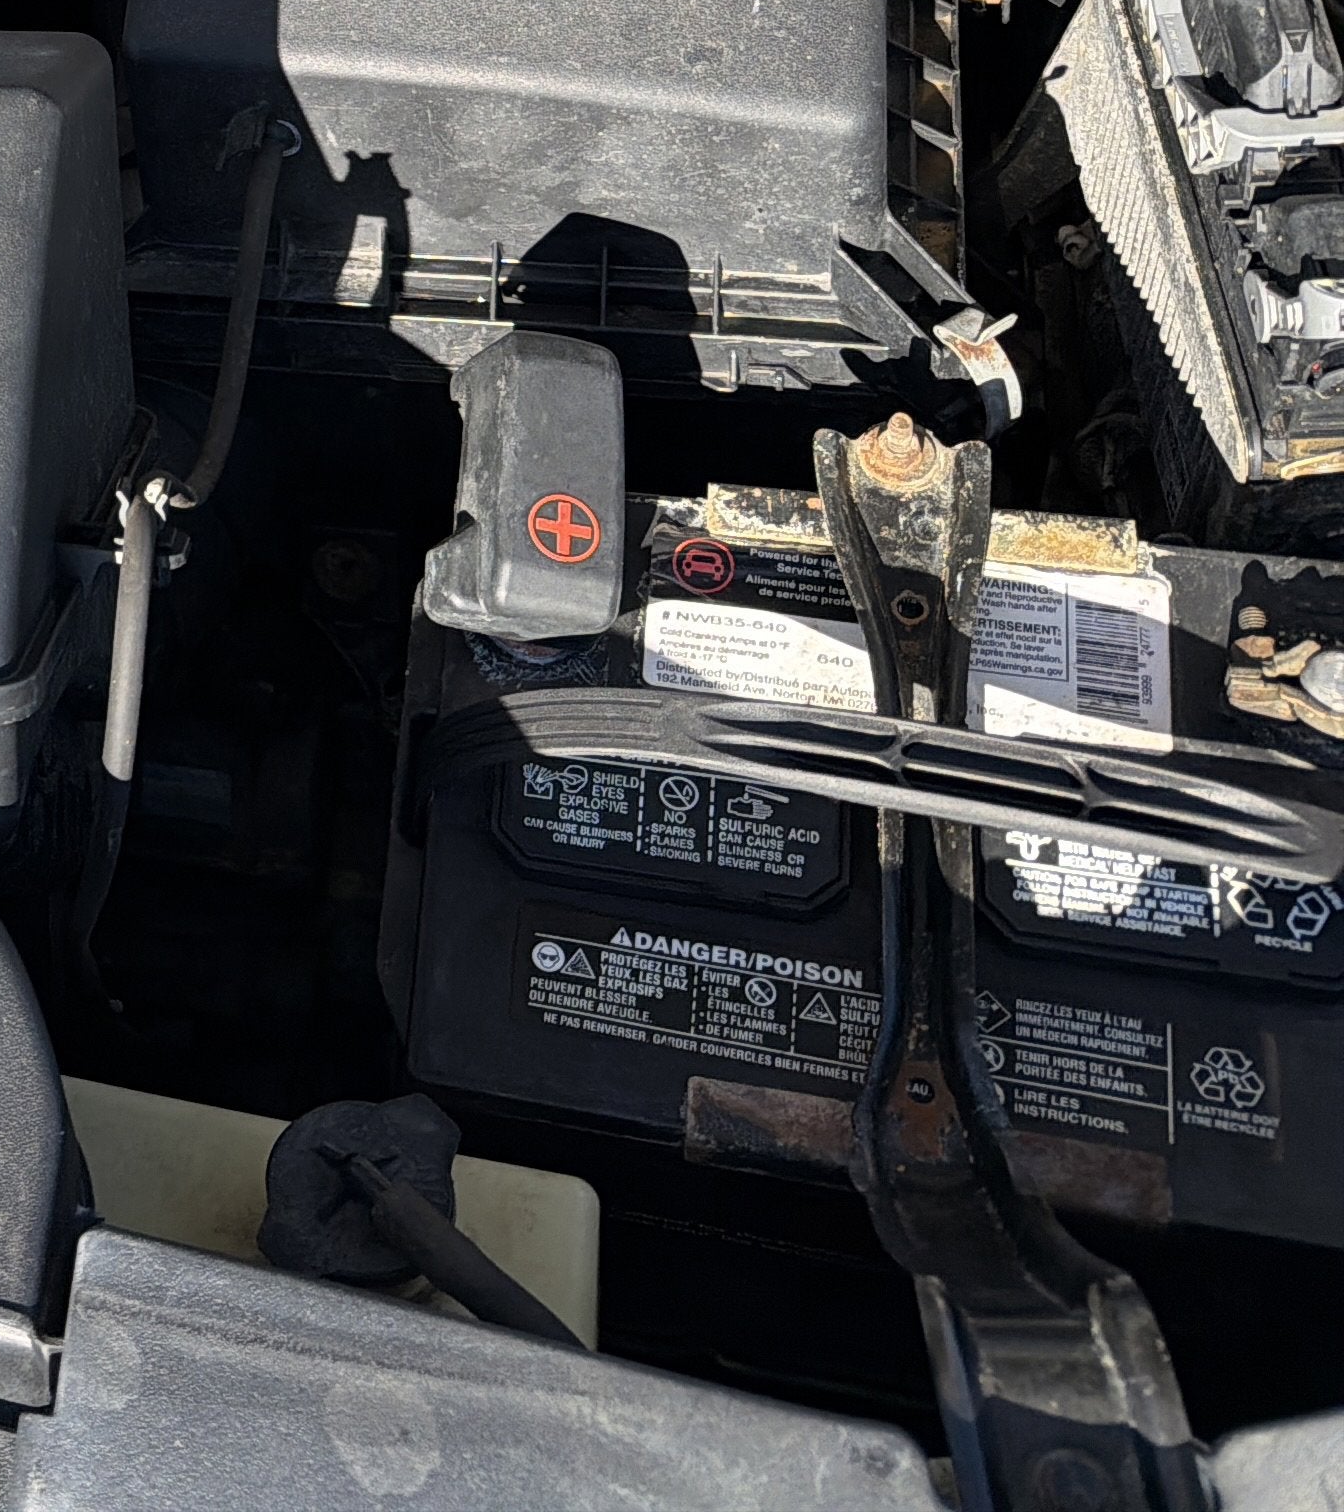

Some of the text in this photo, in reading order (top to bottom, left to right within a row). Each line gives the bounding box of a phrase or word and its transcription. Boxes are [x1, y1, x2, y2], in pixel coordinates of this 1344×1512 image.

[750, 548, 818, 567] Powered for
[776, 563, 820, 579] Service
[745, 574, 846, 596] Alimenté pour les
[758, 586, 819, 603] de service
[981, 598, 1058, 614] Wash hands after
[990, 591, 1003, 600] and
[1004, 592, 1063, 606] Reproductive
[661, 610, 788, 634] # NWB35-640
[976, 618, 1062, 637] RTISSEMENT:
[659, 626, 682, 637] Cold
[729, 635, 757, 649] Amps
[985, 630, 994, 638] et
[1015, 633, 1037, 642] nocif
[1039, 636, 1052, 644] sur
[1053, 636, 1062, 645] la
[1010, 641, 1045, 653] Se laver
[703, 645, 716, 653] au
[979, 647, 1004, 658] après
[1006, 650, 1063, 664] manipulation.
[817, 653, 854, 668] 640
[656, 660, 722, 678] Distributed
[725, 668, 800, 689] by/Distribué
[681, 676, 740, 692] Mansfield
[592, 771, 640, 789] SHIELD
[592, 785, 625, 800] EYES
[559, 793, 629, 815] EXPLOSIVE
[558, 808, 600, 824] GASES
[664, 811, 687, 825] NO
[523, 816, 634, 843] CAN CAUSE BLINDNESS
[651, 822, 696, 839] SPARKS
[718, 817, 820, 844] SULFURIC ACID
[552, 833, 606, 849] OR INJURY
[650, 835, 695, 850] FLAMES
[718, 832, 785, 851] CAN CAUSE
[649, 846, 701, 863] SMOKING
[718, 843, 805, 866] BLINDNESS OR
[717, 855, 803, 878] SEVERE BURNS
[1146, 865, 1176, 882] FAST
[1153, 887, 1209, 905] STARTING
[1145, 896, 1157, 909] IN
[1159, 900, 1205, 916] VEHICLE
[1152, 910, 1210, 929] AVAILABLE
[1254, 934, 1313, 952] RECYCLE
[600, 950, 687, 977] PROTÉGEZ LES
[634, 931, 863, 989] DANGER/POISON
[639, 971, 661, 986] LES
[664, 975, 689, 991] GAZ
[702, 967, 741, 987] ÉVITER
[530, 976, 637, 1007] PEUVENT BLESSER
[598, 976, 664, 1000] EXPLOSIFS
[708, 986, 729, 999] LES
[529, 990, 653, 1023] OU RENDRE AVEUGLE.
[707, 999, 775, 1020] ÉTINCELLES
[1015, 998, 1052, 1015] RINCEZ
[1054, 1004, 1073, 1018] LES
[1075, 1008, 1102, 1023] YEUX
[1113, 1015, 1142, 1030] L'EAU
[706, 1011, 787, 1036] LES FLAMMES
[840, 1022, 869, 1036] PEUT
[705, 1024, 763, 1044] DE FUMER
[1015, 1025, 1149, 1059] UN MÉDECIN RAPIDEMENT.
[1104, 1027, 1163, 1047] CONSULTEZ
[543, 1011, 559, 1025] NE
[561, 1013, 581, 1028] PAS
[652, 1034, 698, 1053] GARDER
[700, 1042, 772, 1066] COUVERCLES
[774, 1057, 801, 1072] BIEN
[803, 1059, 849, 1082] FERMÉS
[852, 1071, 866, 1084] ET
[1015, 1049, 1124, 1078] TENIR HORS DE LA
[1014, 1063, 1148, 1097] PORTÉE DES ENFANTS.
[1014, 1088, 1081, 1110] LIRE LES
[1177, 1101, 1193, 1114] LA
[1014, 1103, 1129, 1134] INSTRUCTIONS.
